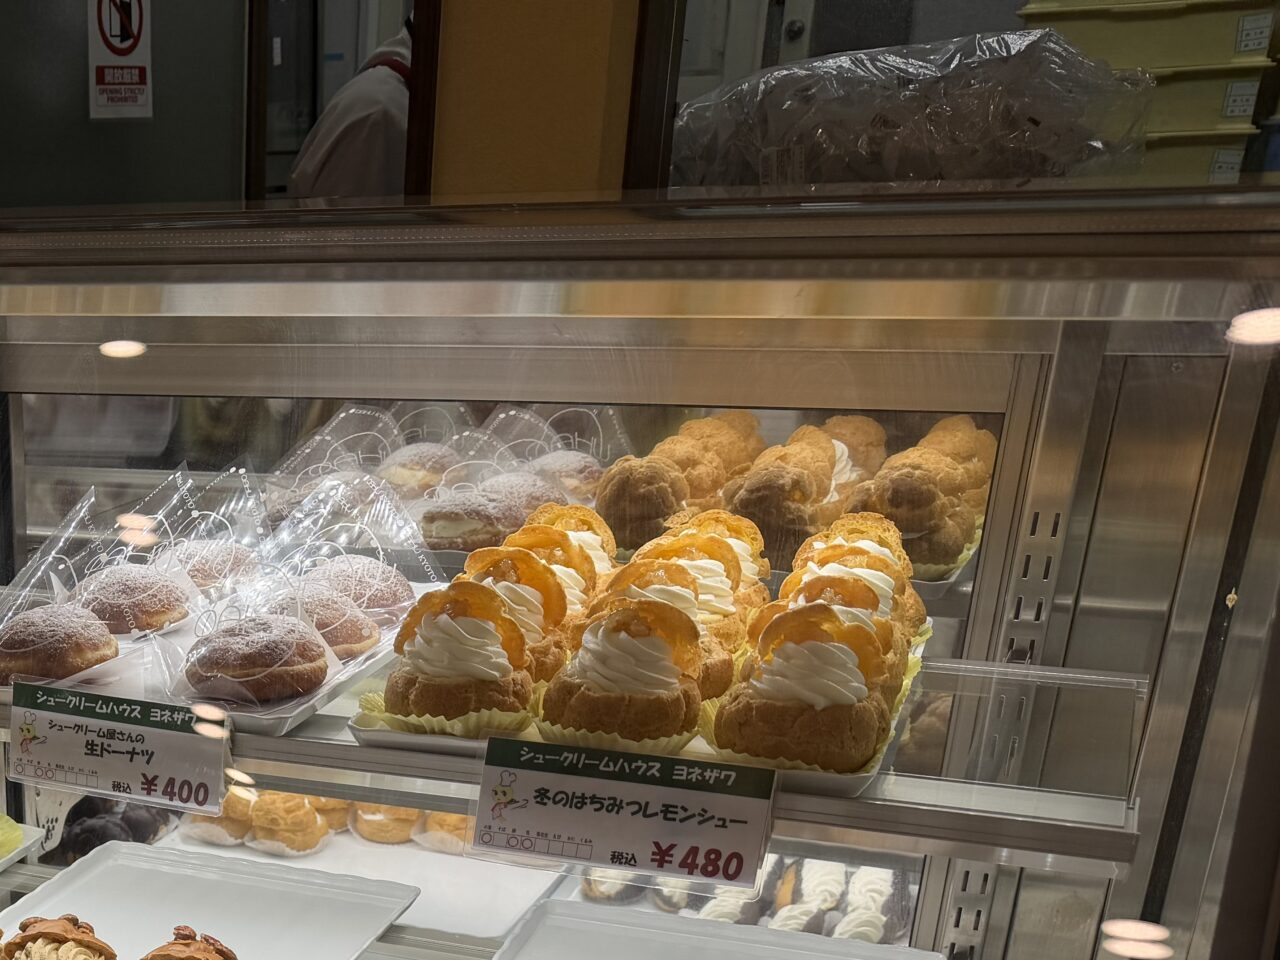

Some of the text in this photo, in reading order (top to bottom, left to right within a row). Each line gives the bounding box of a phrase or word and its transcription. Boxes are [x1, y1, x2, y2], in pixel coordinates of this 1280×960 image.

[98, 87, 122, 96] OPENING
[106, 95, 138, 104] PROHIBITED
[418, 554, 438, 582] KYOTO
[36, 690, 196, 728] シュークリームハウス ヨネザワ
[48, 719, 145, 744] シュークリーム屋さんの
[84, 739, 155, 766] 生ドーナツ
[519, 746, 736, 787] シュークリームハウス ヨネザワ
[112, 772, 209, 806] 税込 ¥400
[532, 786, 748, 830] 冬のはちみつレモンシュー
[610, 840, 744, 882] 税込 ¥480
